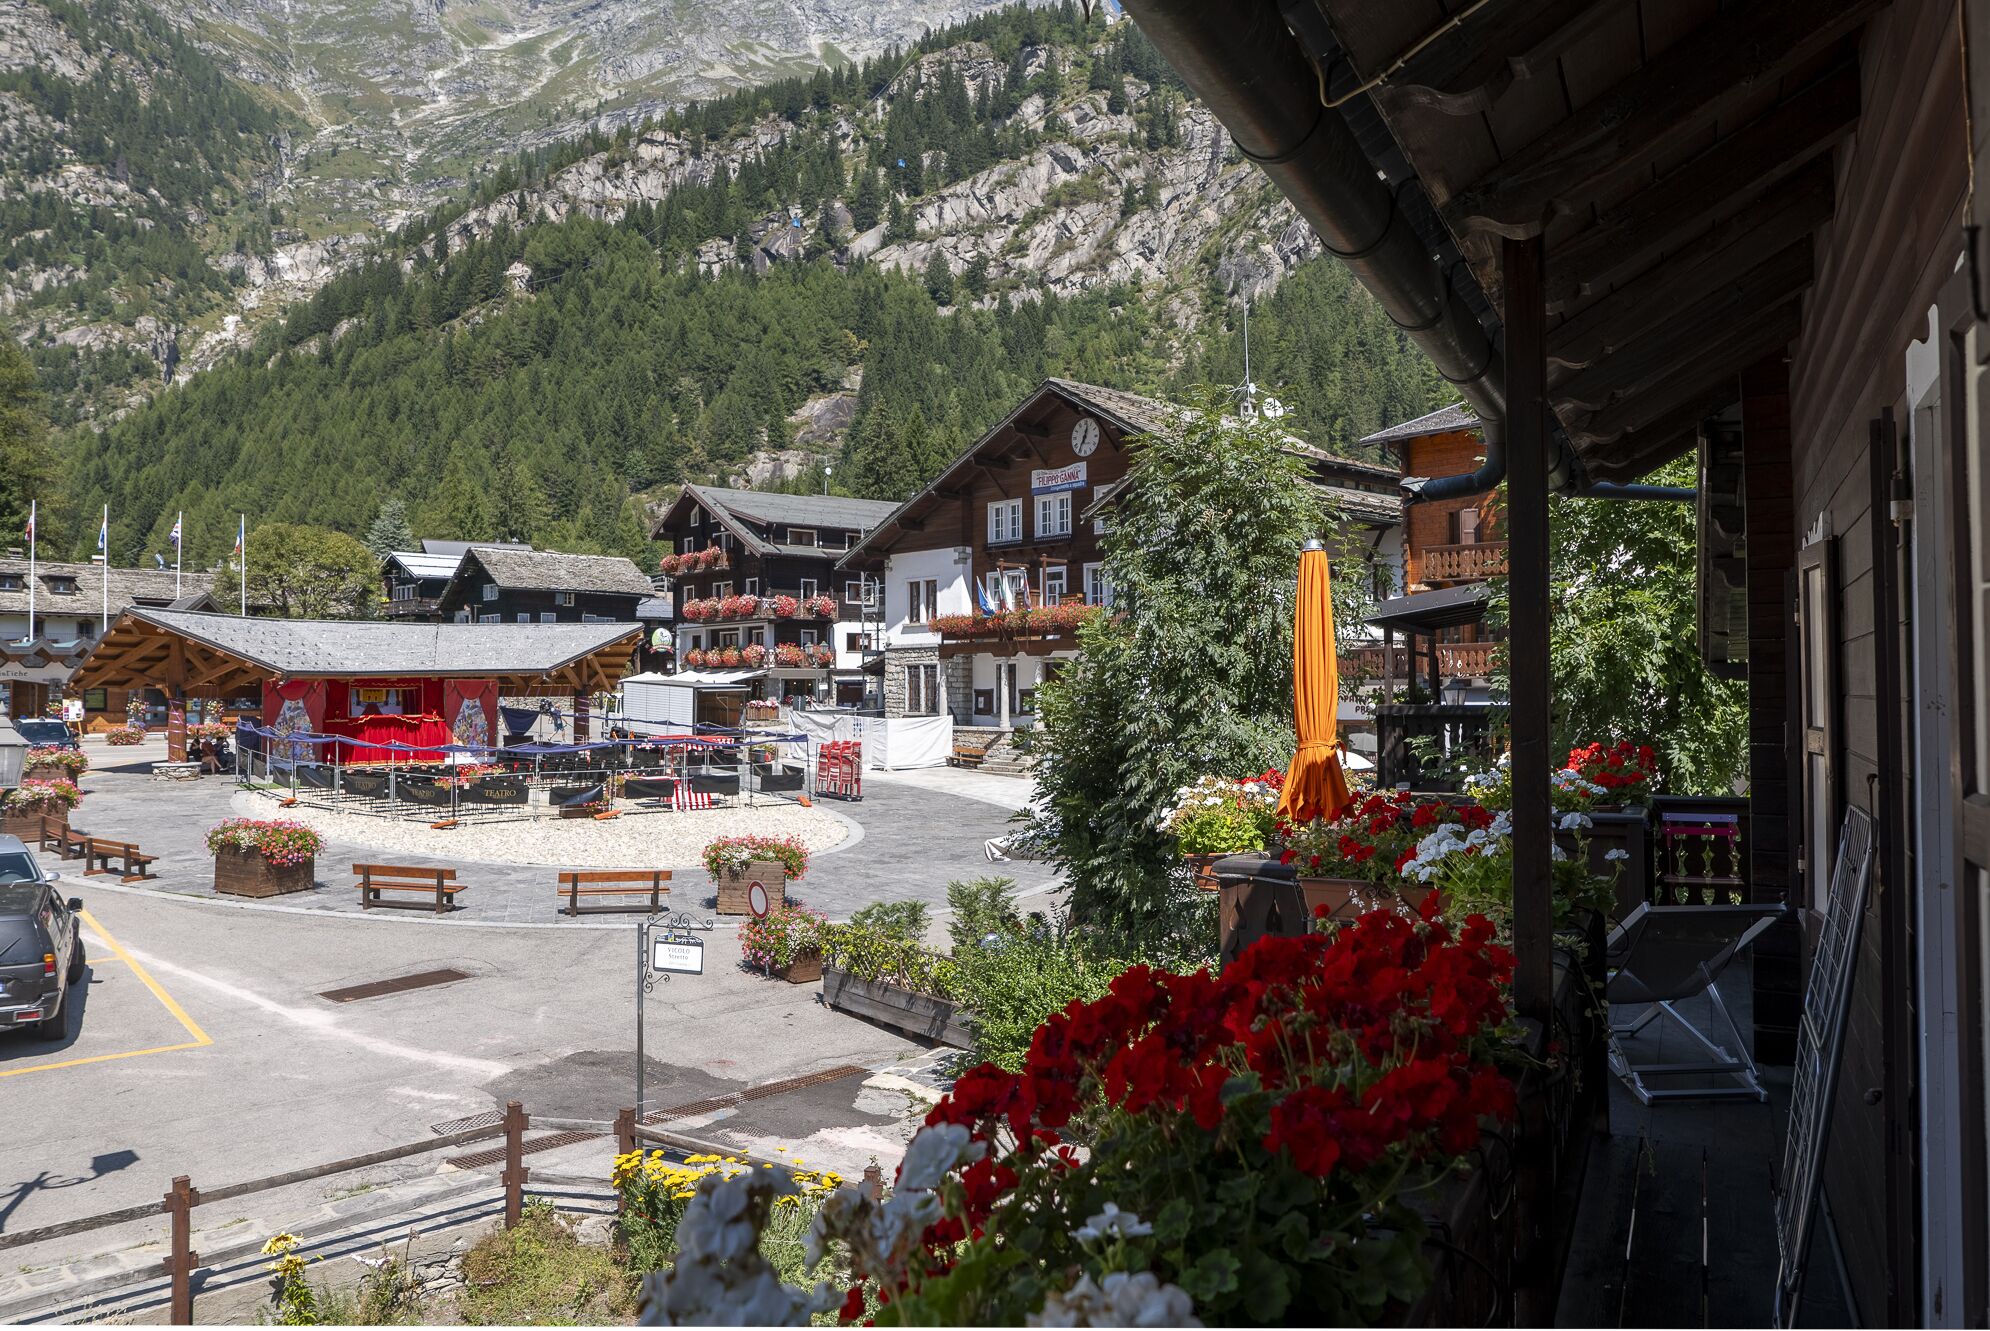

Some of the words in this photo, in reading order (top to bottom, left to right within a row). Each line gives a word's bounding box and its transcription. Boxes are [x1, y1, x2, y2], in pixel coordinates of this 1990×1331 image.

[410, 787, 435, 798] TEATRO
[484, 789, 517, 798] TEATRO
[667, 947, 691, 955] VICOLO
